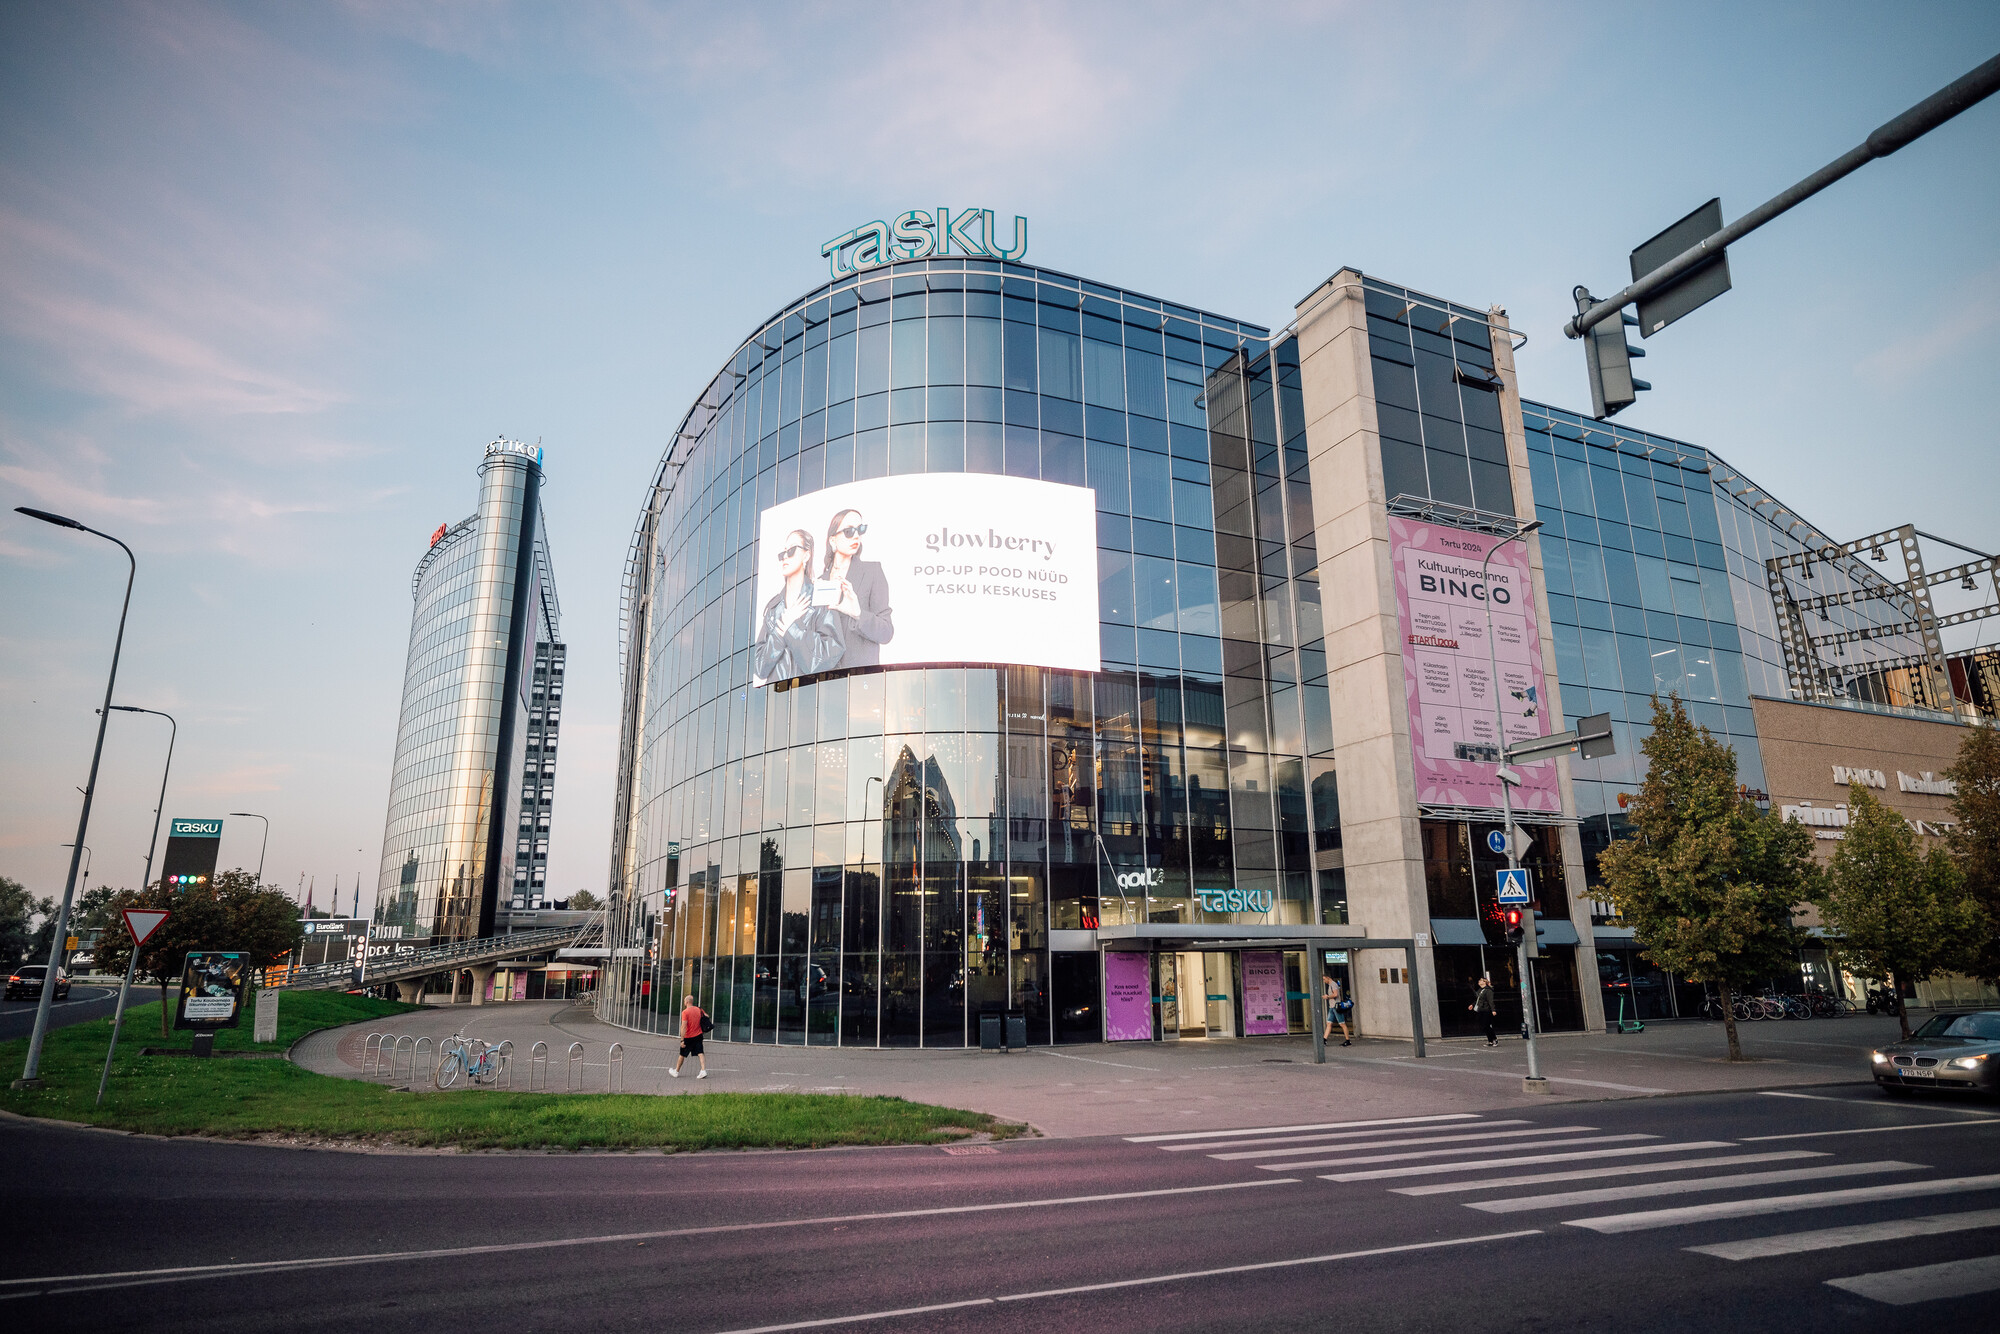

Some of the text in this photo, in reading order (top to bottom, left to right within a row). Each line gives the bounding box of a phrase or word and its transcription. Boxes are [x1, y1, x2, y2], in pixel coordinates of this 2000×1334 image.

[485, 440, 537, 457] ESTIKO
[925, 527, 1056, 561] glowberry
[1440, 537, 1482, 553] Tartu 2024
[913, 565, 1068, 584] POP-UP POOD NÜÜD
[1418, 559, 1509, 584] Kultuuripeainna
[926, 583, 1057, 601] TASKU KESKUSES
[1420, 575, 1511, 604] BINGO
[1781, 802, 1850, 827] Rimi
[350, 945, 391, 957] LDEX
